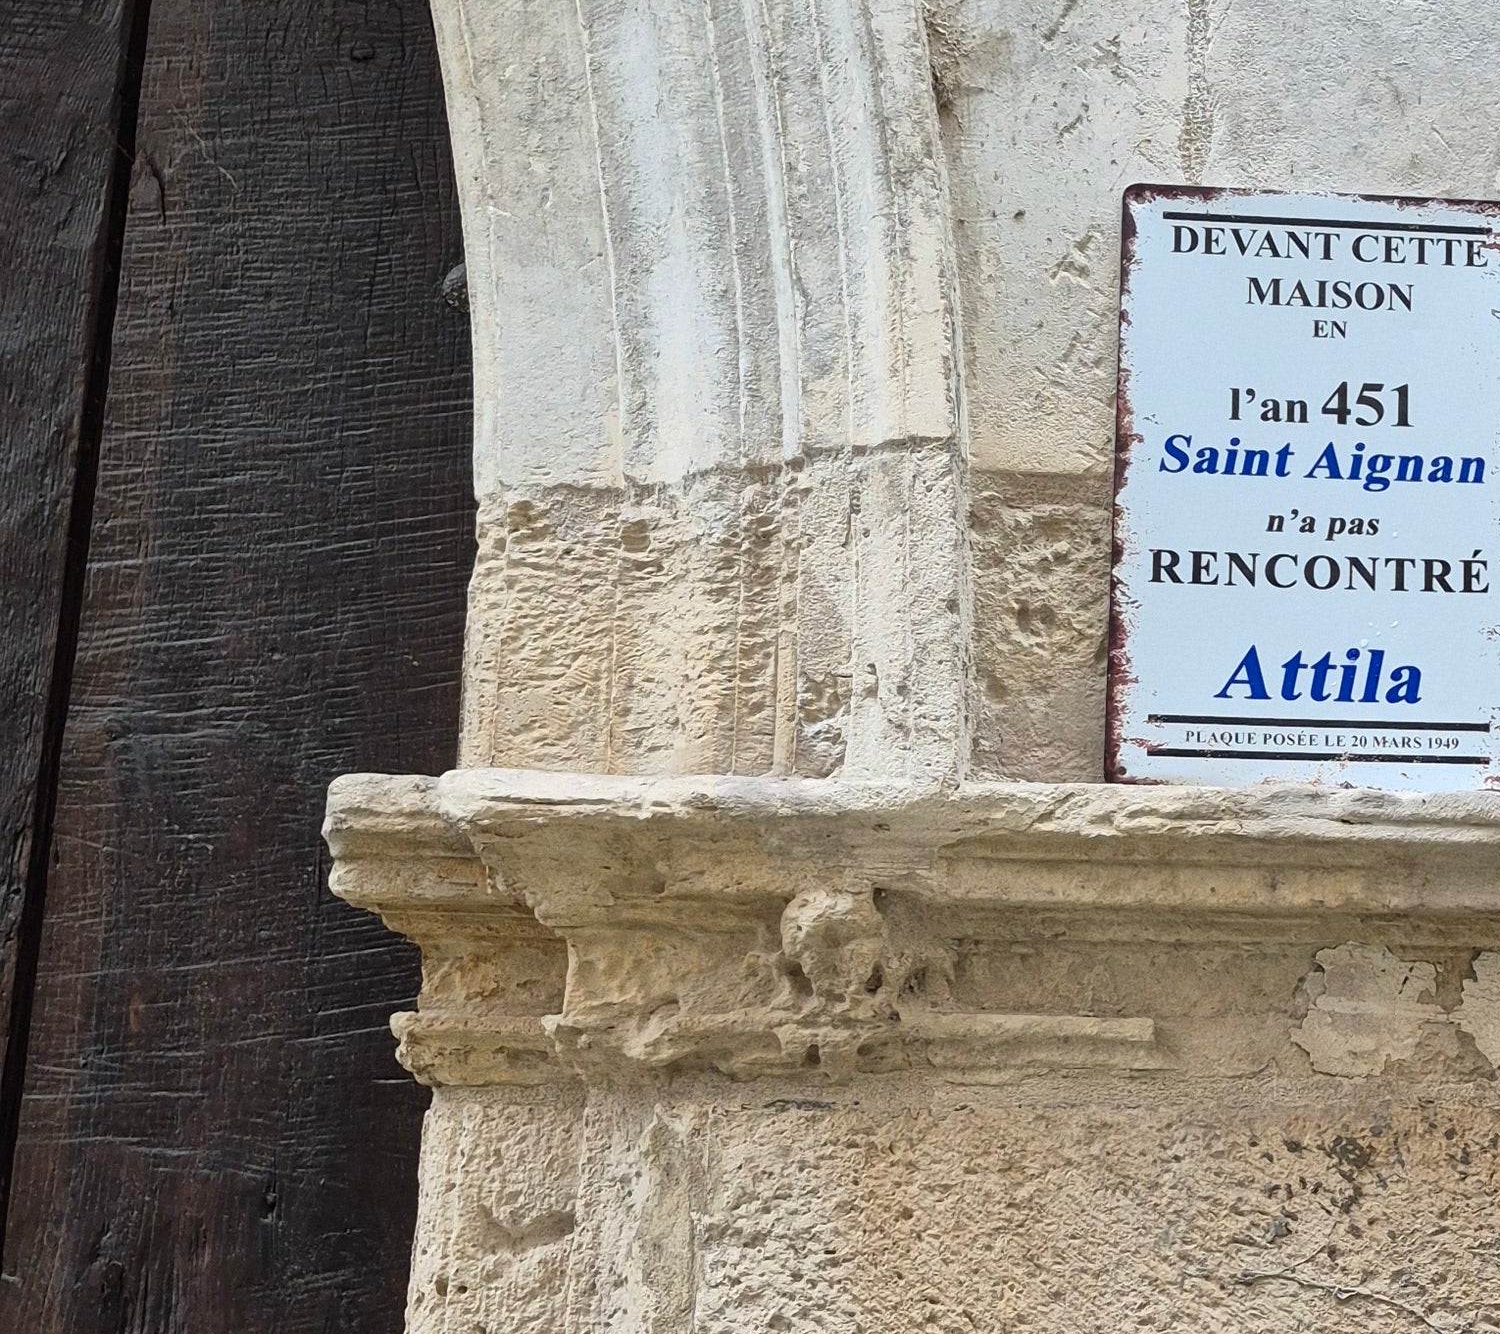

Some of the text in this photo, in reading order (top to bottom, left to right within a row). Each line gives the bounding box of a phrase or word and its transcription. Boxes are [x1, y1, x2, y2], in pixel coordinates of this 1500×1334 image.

[1171, 225, 1489, 268] DEVANT CETTE
[1246, 276, 1415, 313] MAISON
[1312, 319, 1348, 339] EN
[1321, 381, 1414, 427] 451
[1158, 433, 1487, 492] Saint Aignan
[1325, 516, 1380, 542] pas
[1147, 548, 1491, 594] RENCONTRÉ
[1213, 643, 1424, 706] Attila
[1185, 730, 1460, 750] PLAQUE POSÉE LE 20 MARS 1949
